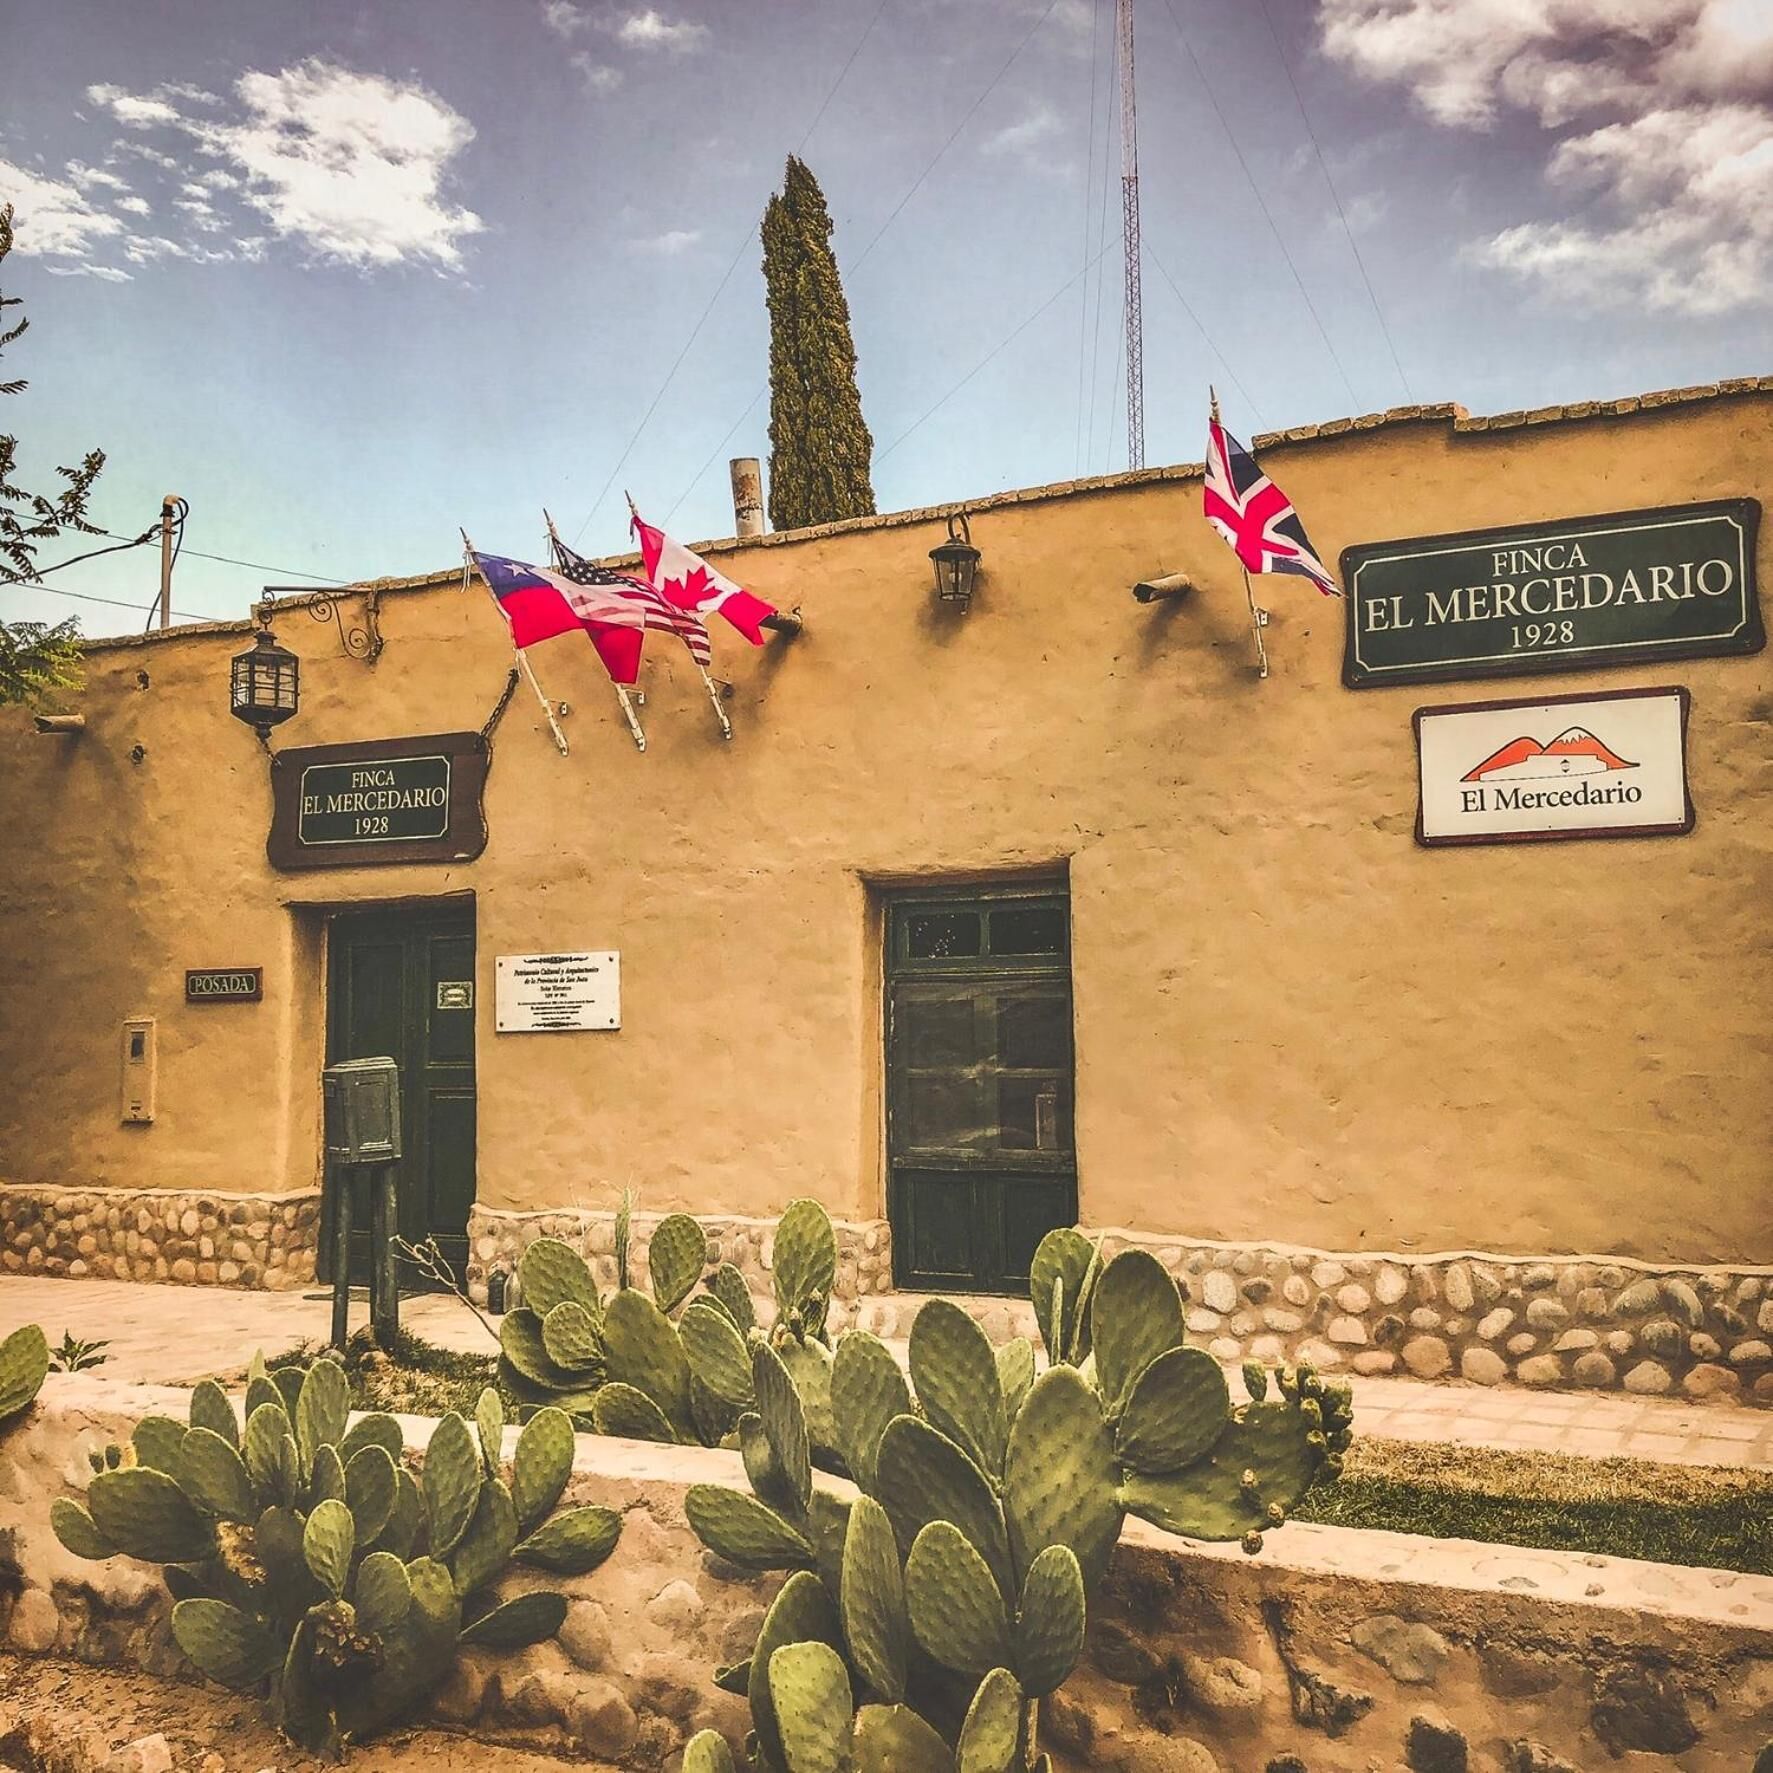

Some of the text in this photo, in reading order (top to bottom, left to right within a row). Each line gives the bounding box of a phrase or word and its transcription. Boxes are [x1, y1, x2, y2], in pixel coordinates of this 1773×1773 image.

[1491, 542, 1590, 578] FINCA
[1364, 558, 1735, 633] EL MERCEDARIO
[1510, 620, 1576, 649] 1928
[351, 769, 396, 789] FINCA
[303, 787, 446, 816] EL MERCEDARIO
[1459, 780, 1643, 814] El Mercedario
[354, 815, 390, 836] 1928
[194, 976, 249, 993] POSADA
